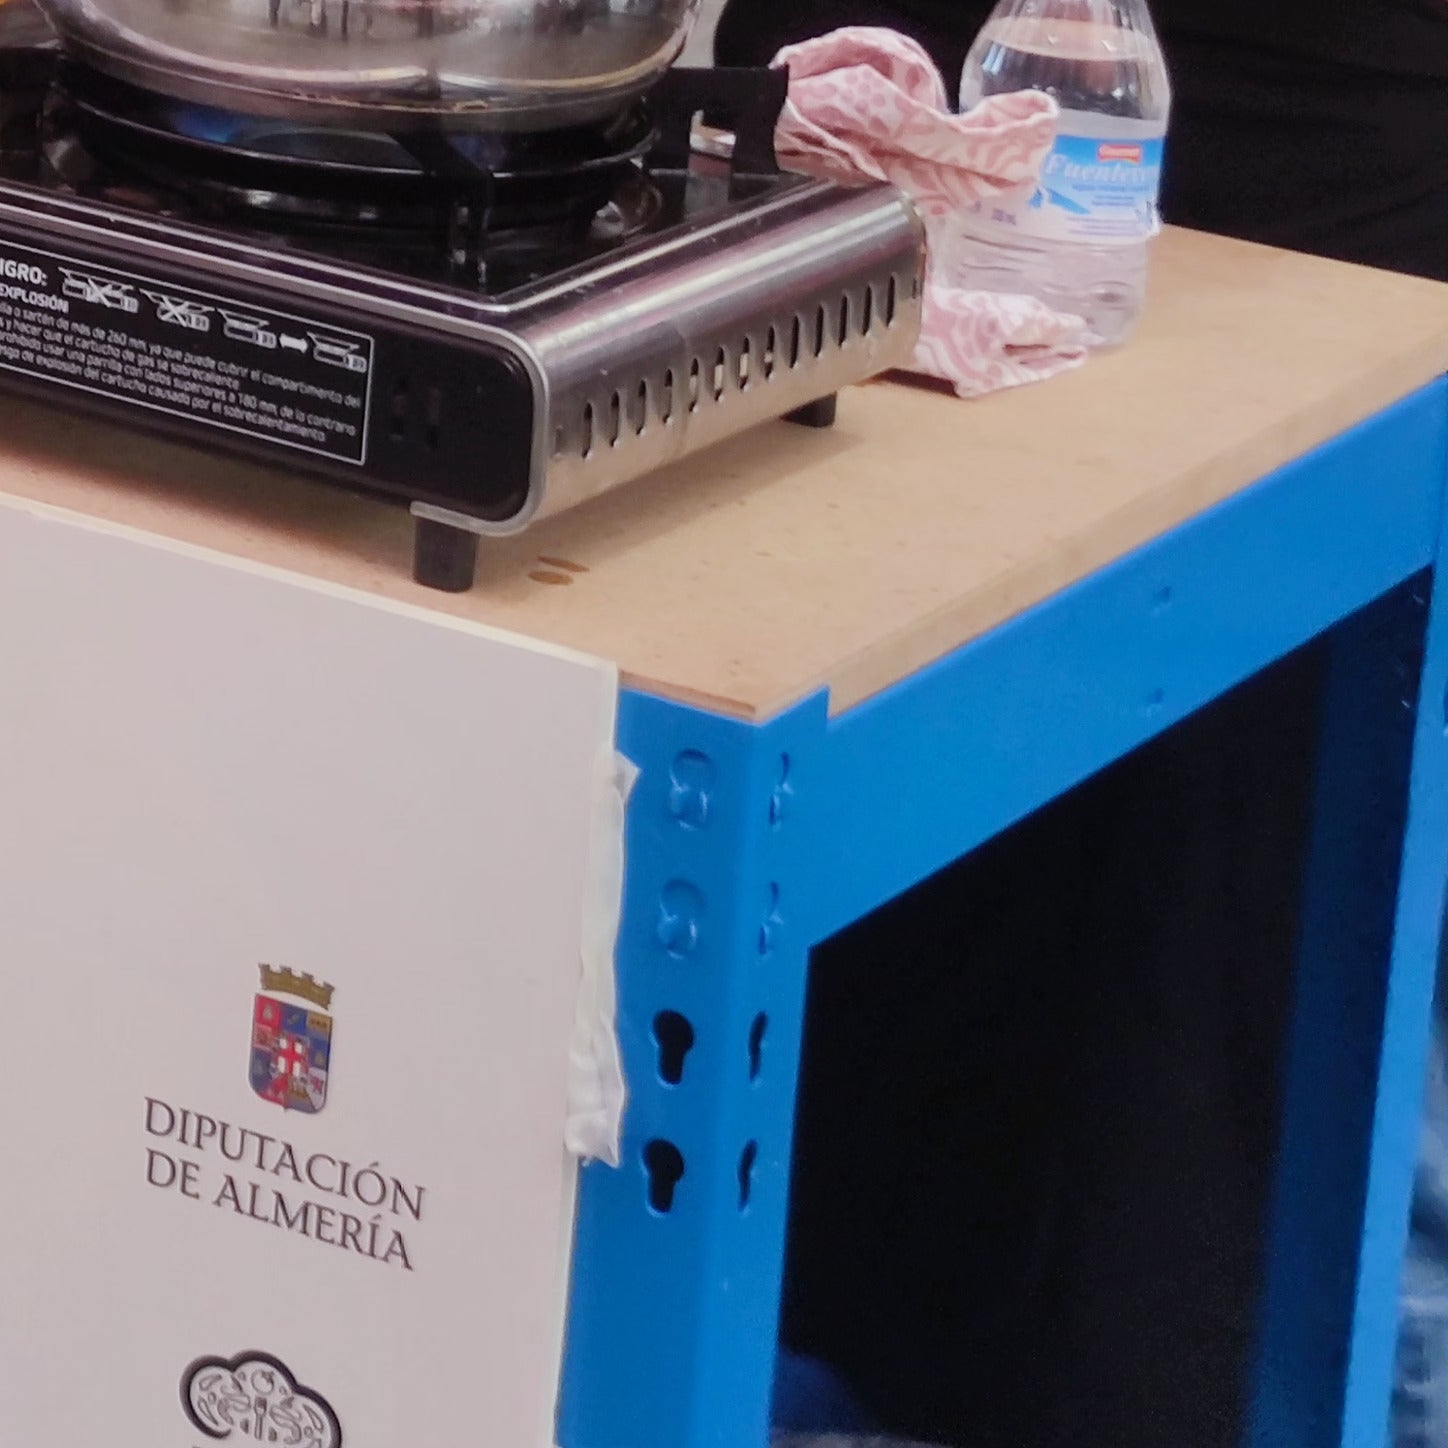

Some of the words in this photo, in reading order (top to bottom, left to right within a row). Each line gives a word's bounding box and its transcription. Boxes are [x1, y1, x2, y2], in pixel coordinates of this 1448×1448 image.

[143, 1095, 426, 1222] DIPUTACIÓN
[145, 1147, 201, 1200] DE
[212, 1173, 415, 1272] ALMERÍA
